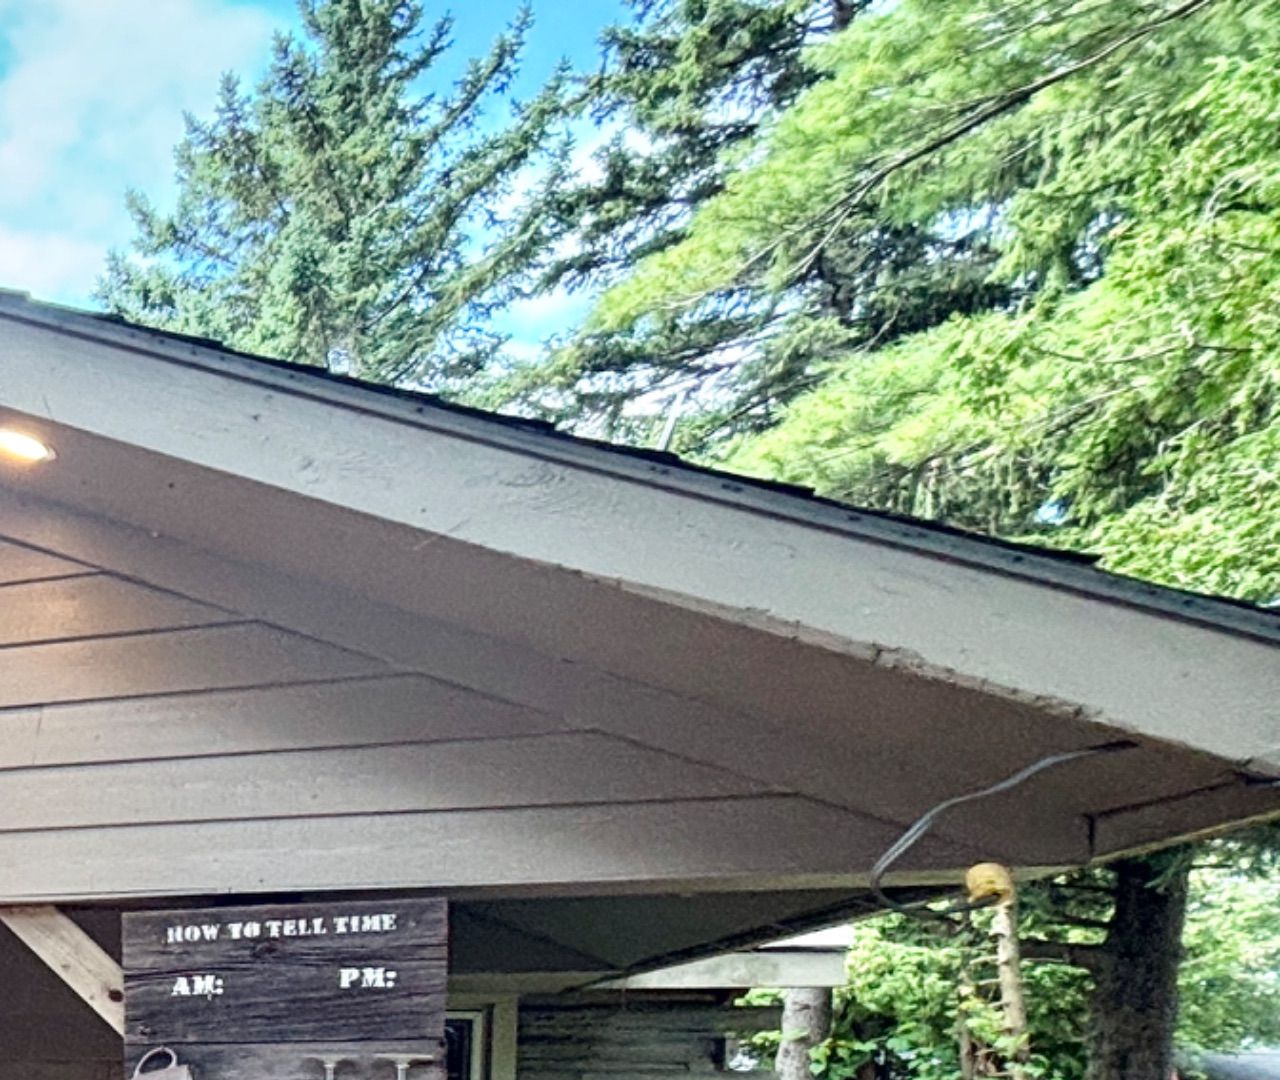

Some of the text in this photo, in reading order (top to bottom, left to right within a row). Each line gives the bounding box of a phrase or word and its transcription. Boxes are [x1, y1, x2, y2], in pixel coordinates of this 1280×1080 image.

[167, 914, 398, 943] HOW TO TELL TIME
[171, 975, 224, 997] AM:
[339, 968, 397, 989] PM:
